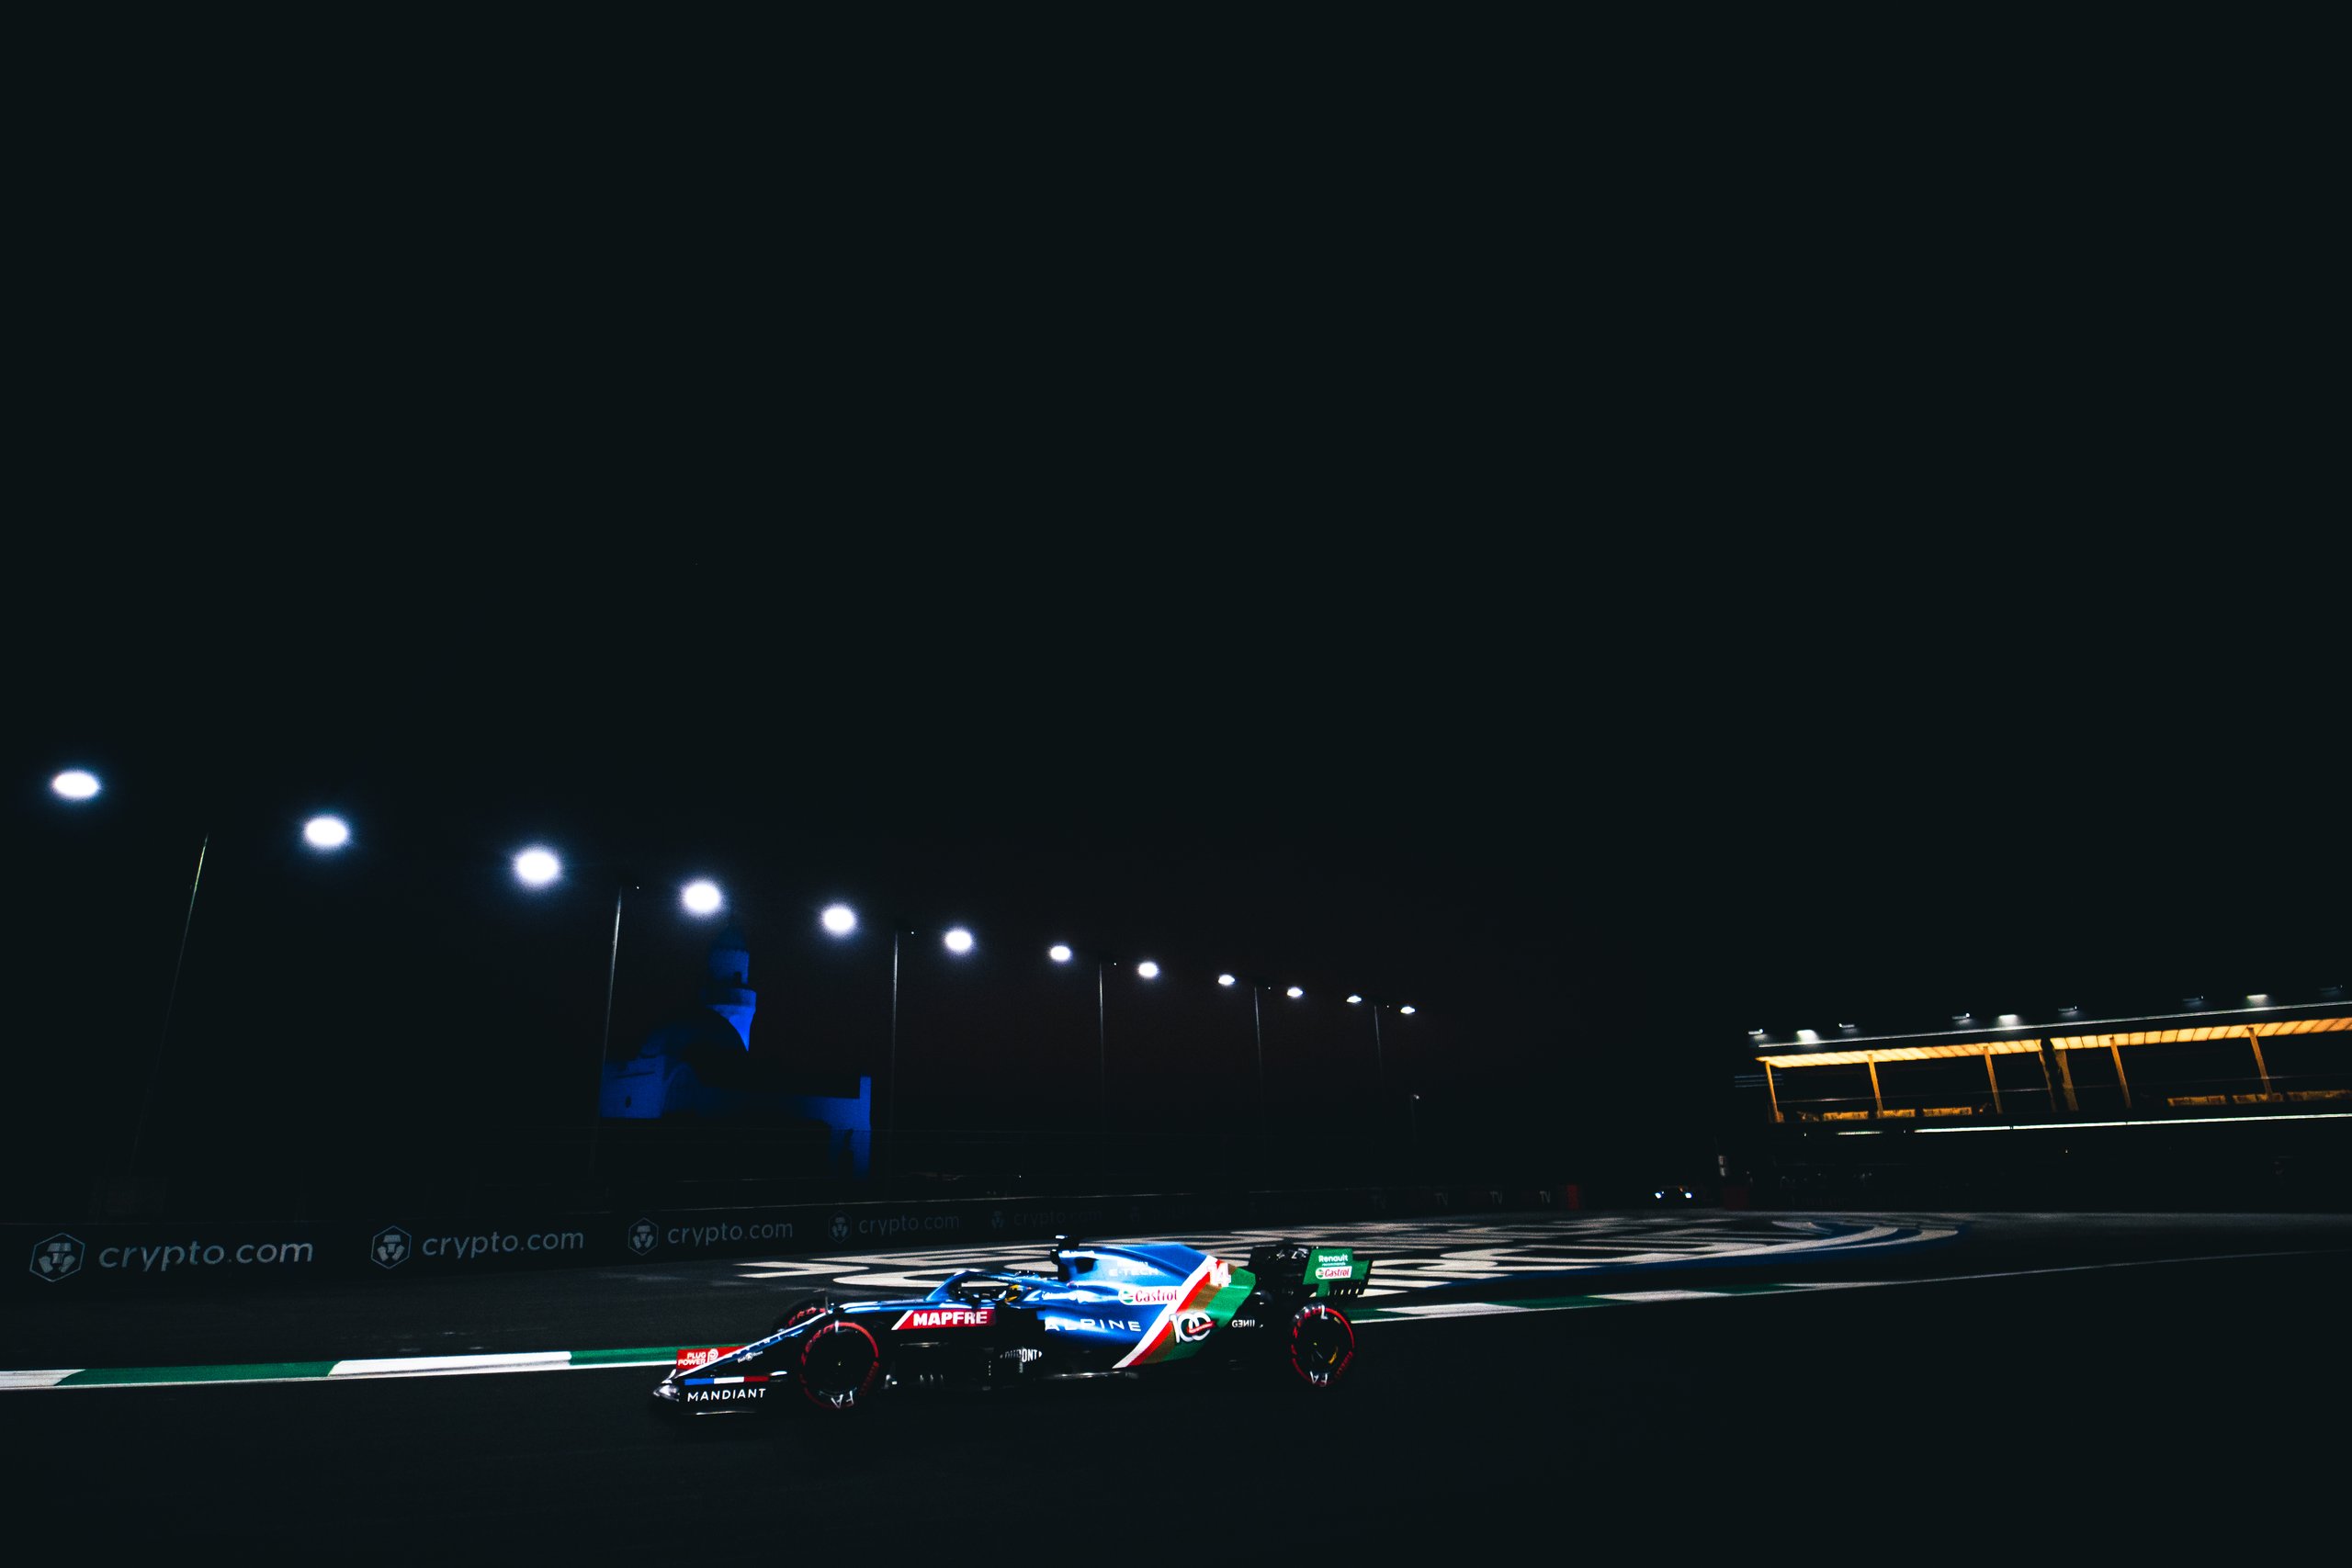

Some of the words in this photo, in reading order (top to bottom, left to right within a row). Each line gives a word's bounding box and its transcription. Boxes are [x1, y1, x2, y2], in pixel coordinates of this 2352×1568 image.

[858, 1212, 960, 1235] crypto.com
[667, 1219, 794, 1247] crypto.com
[421, 1228, 585, 1259] crypto.com
[97, 1240, 314, 1273] crypto.com
[1318, 1253, 1348, 1262] Renault
[1206, 1262, 1232, 1287] 14
[1324, 1268, 1350, 1278] Castrol
[1135, 1289, 1178, 1302] Castrol
[912, 1310, 988, 1327] MAPFRE
[1045, 1316, 1142, 1332] ALPINE
[677, 1358, 707, 1366] POWER
[686, 1351, 707, 1359] PLUG
[686, 1388, 767, 1403] MANDIANT
